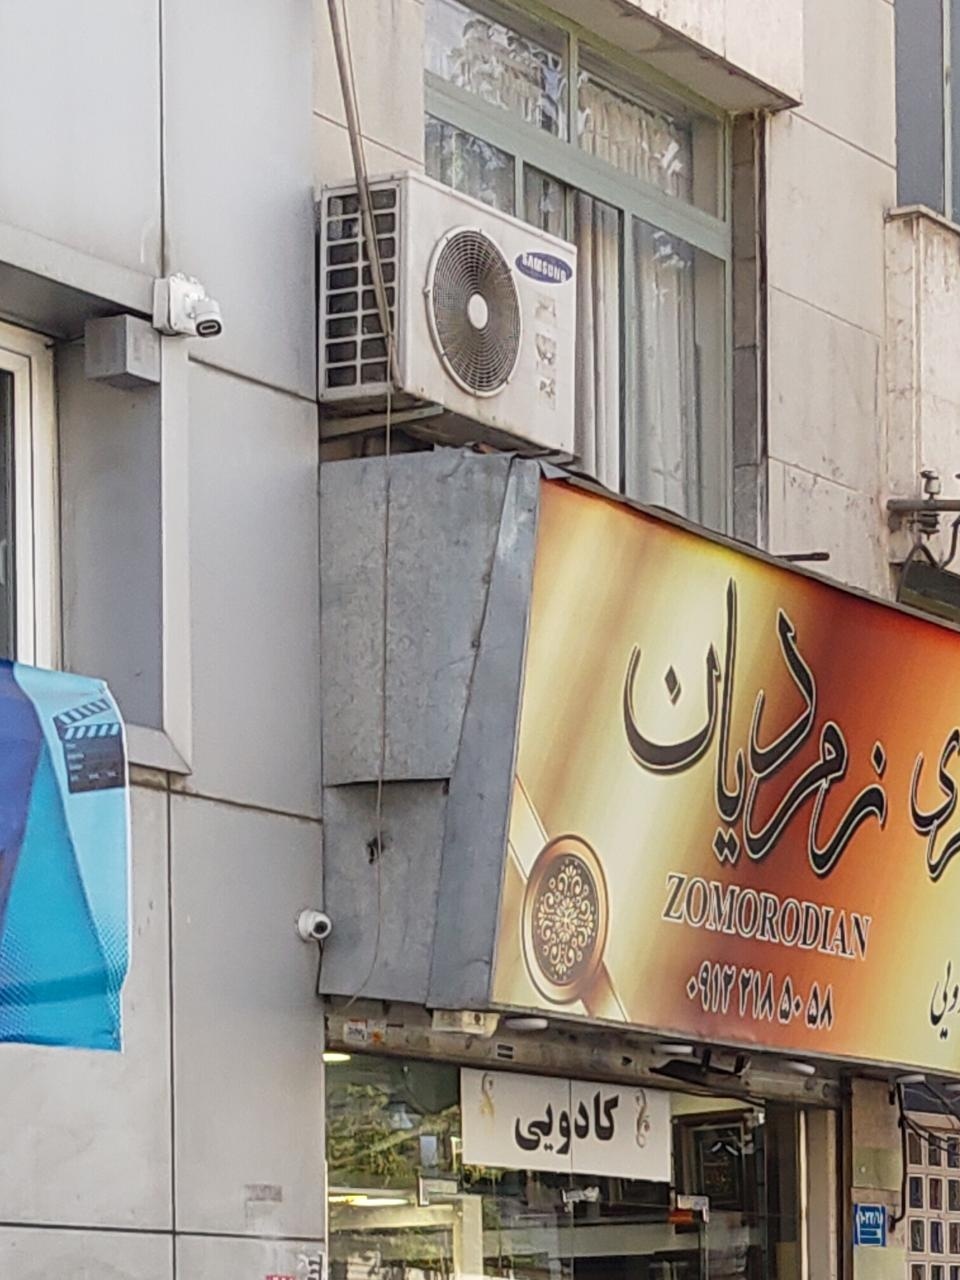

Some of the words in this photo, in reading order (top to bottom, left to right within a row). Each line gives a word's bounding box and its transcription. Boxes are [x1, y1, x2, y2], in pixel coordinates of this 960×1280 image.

[522, 252, 567, 282] SAMSUNG
[622, 576, 887, 878] زمردیان
[661, 872, 872, 961] ZOMORODIAN
[514, 1090, 619, 1155] کادویی
